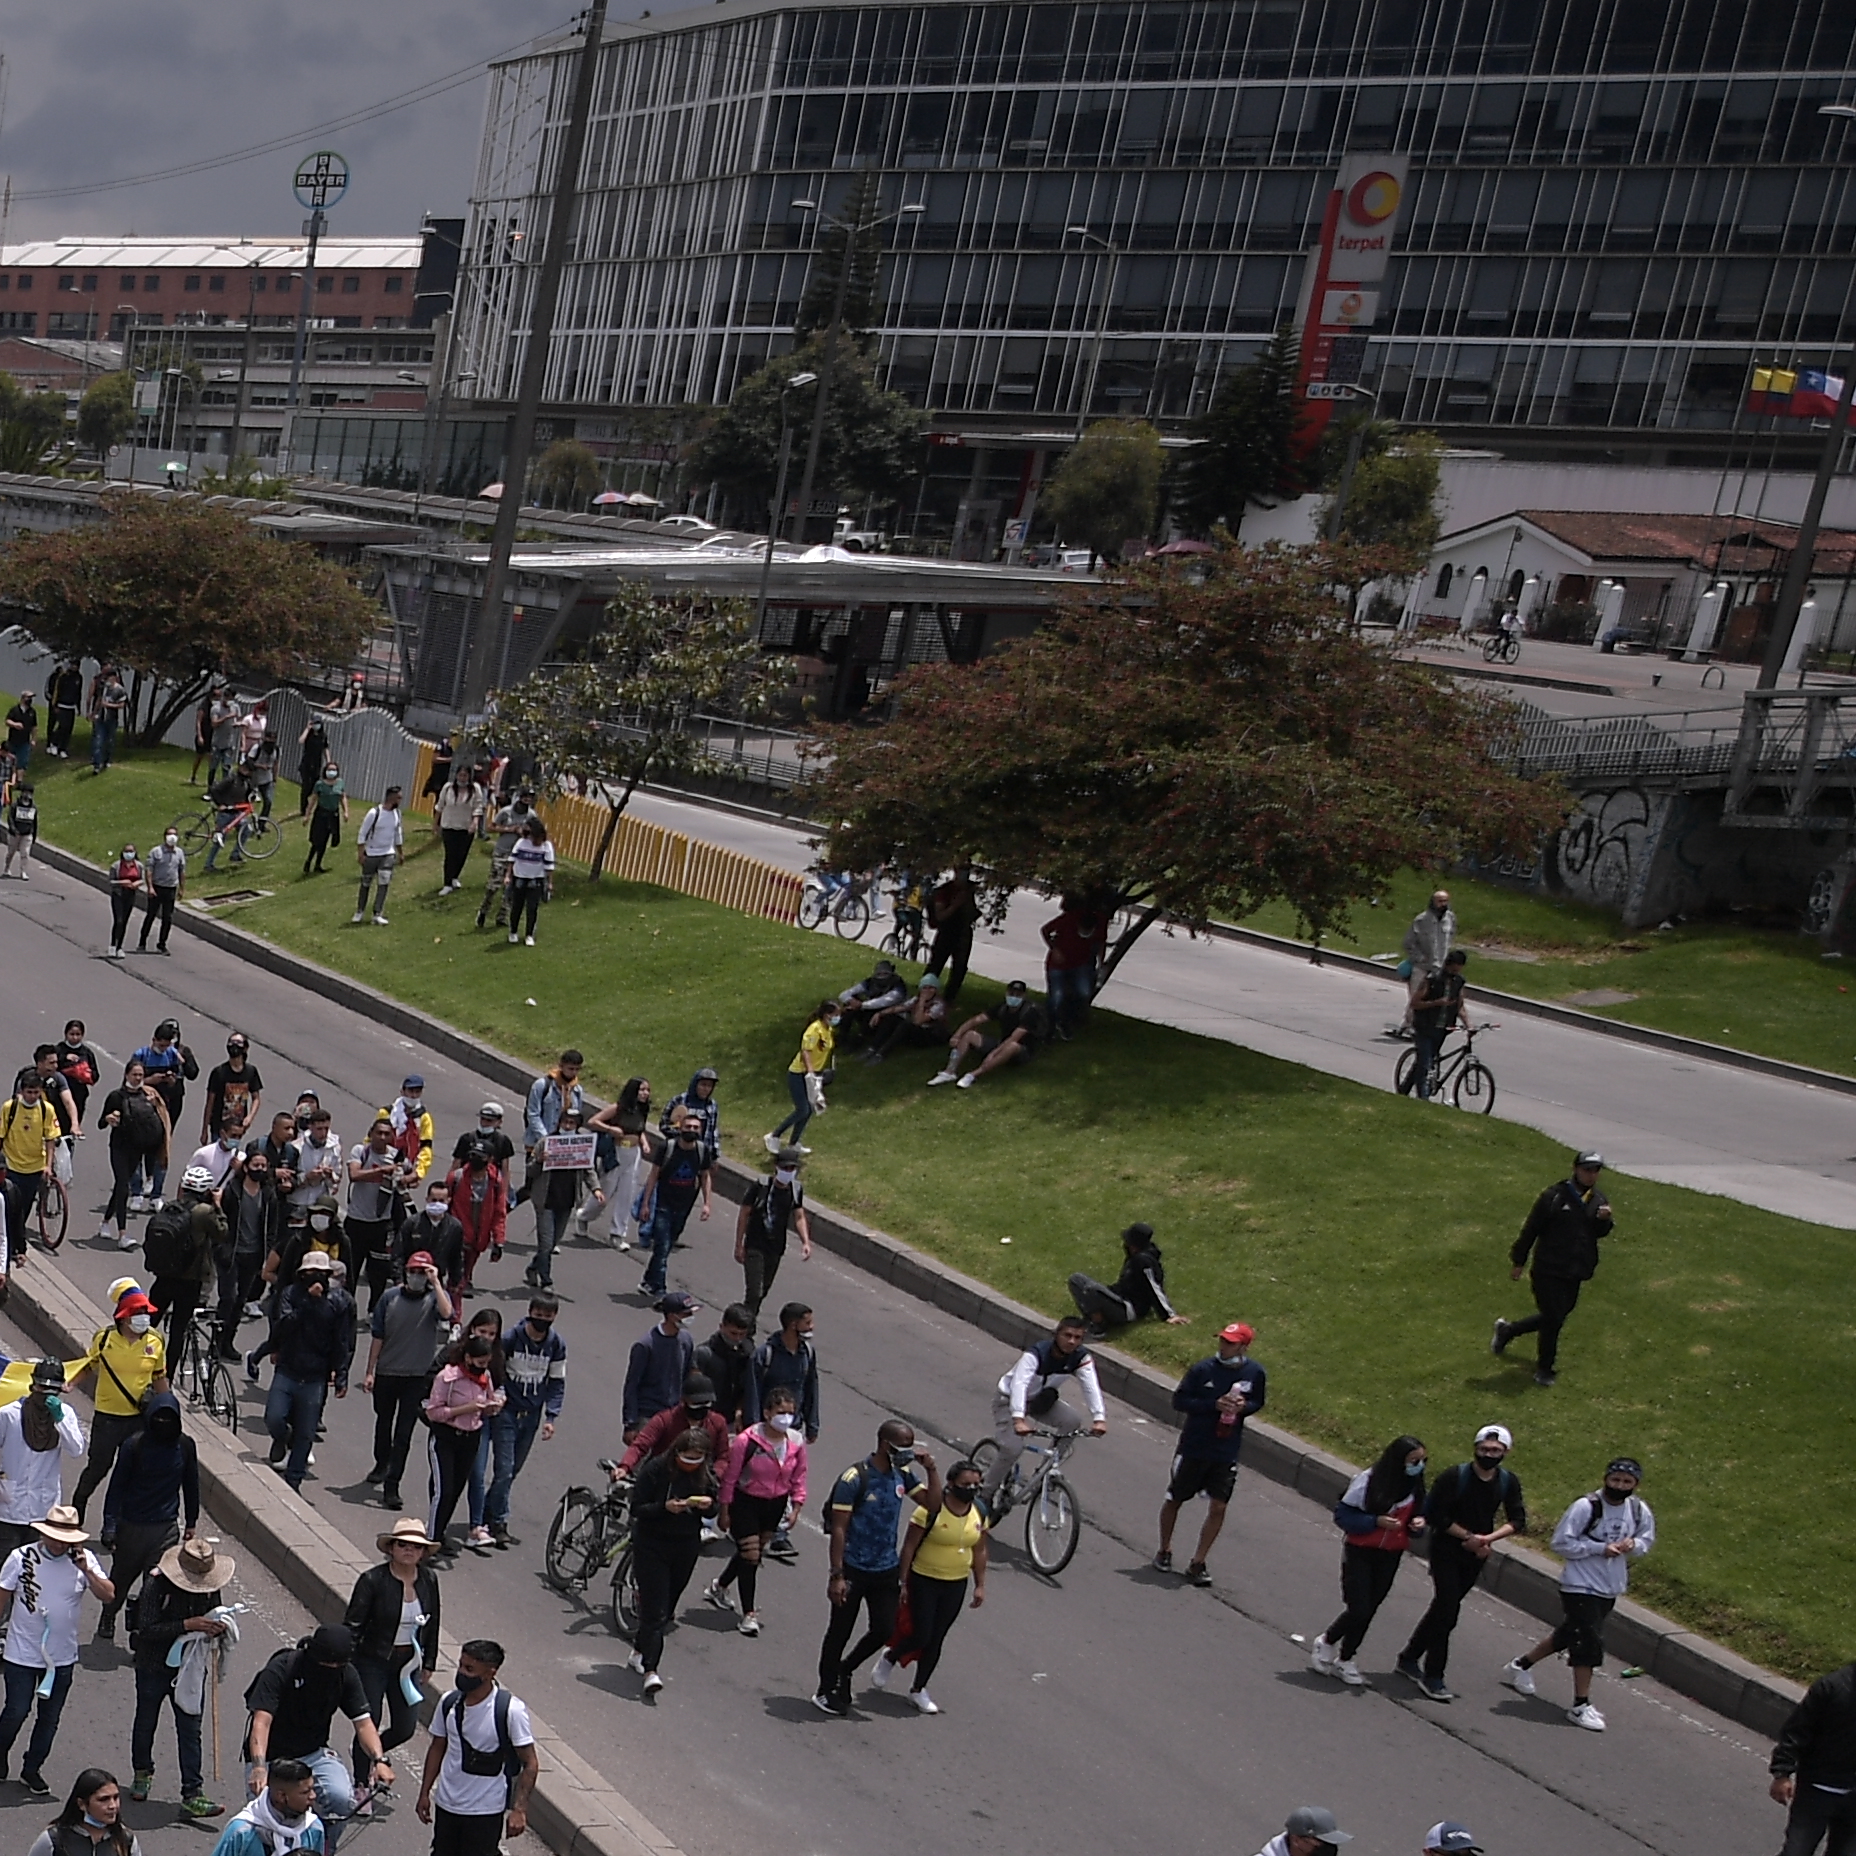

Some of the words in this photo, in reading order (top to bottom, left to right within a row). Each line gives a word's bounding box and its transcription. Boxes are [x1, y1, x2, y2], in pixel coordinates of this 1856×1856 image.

[297, 175, 345, 186] BAYER
[314, 155, 329, 206] BAYER
[1338, 235, 1386, 253] terpel
[19, 1546, 42, 1614] Surfing
